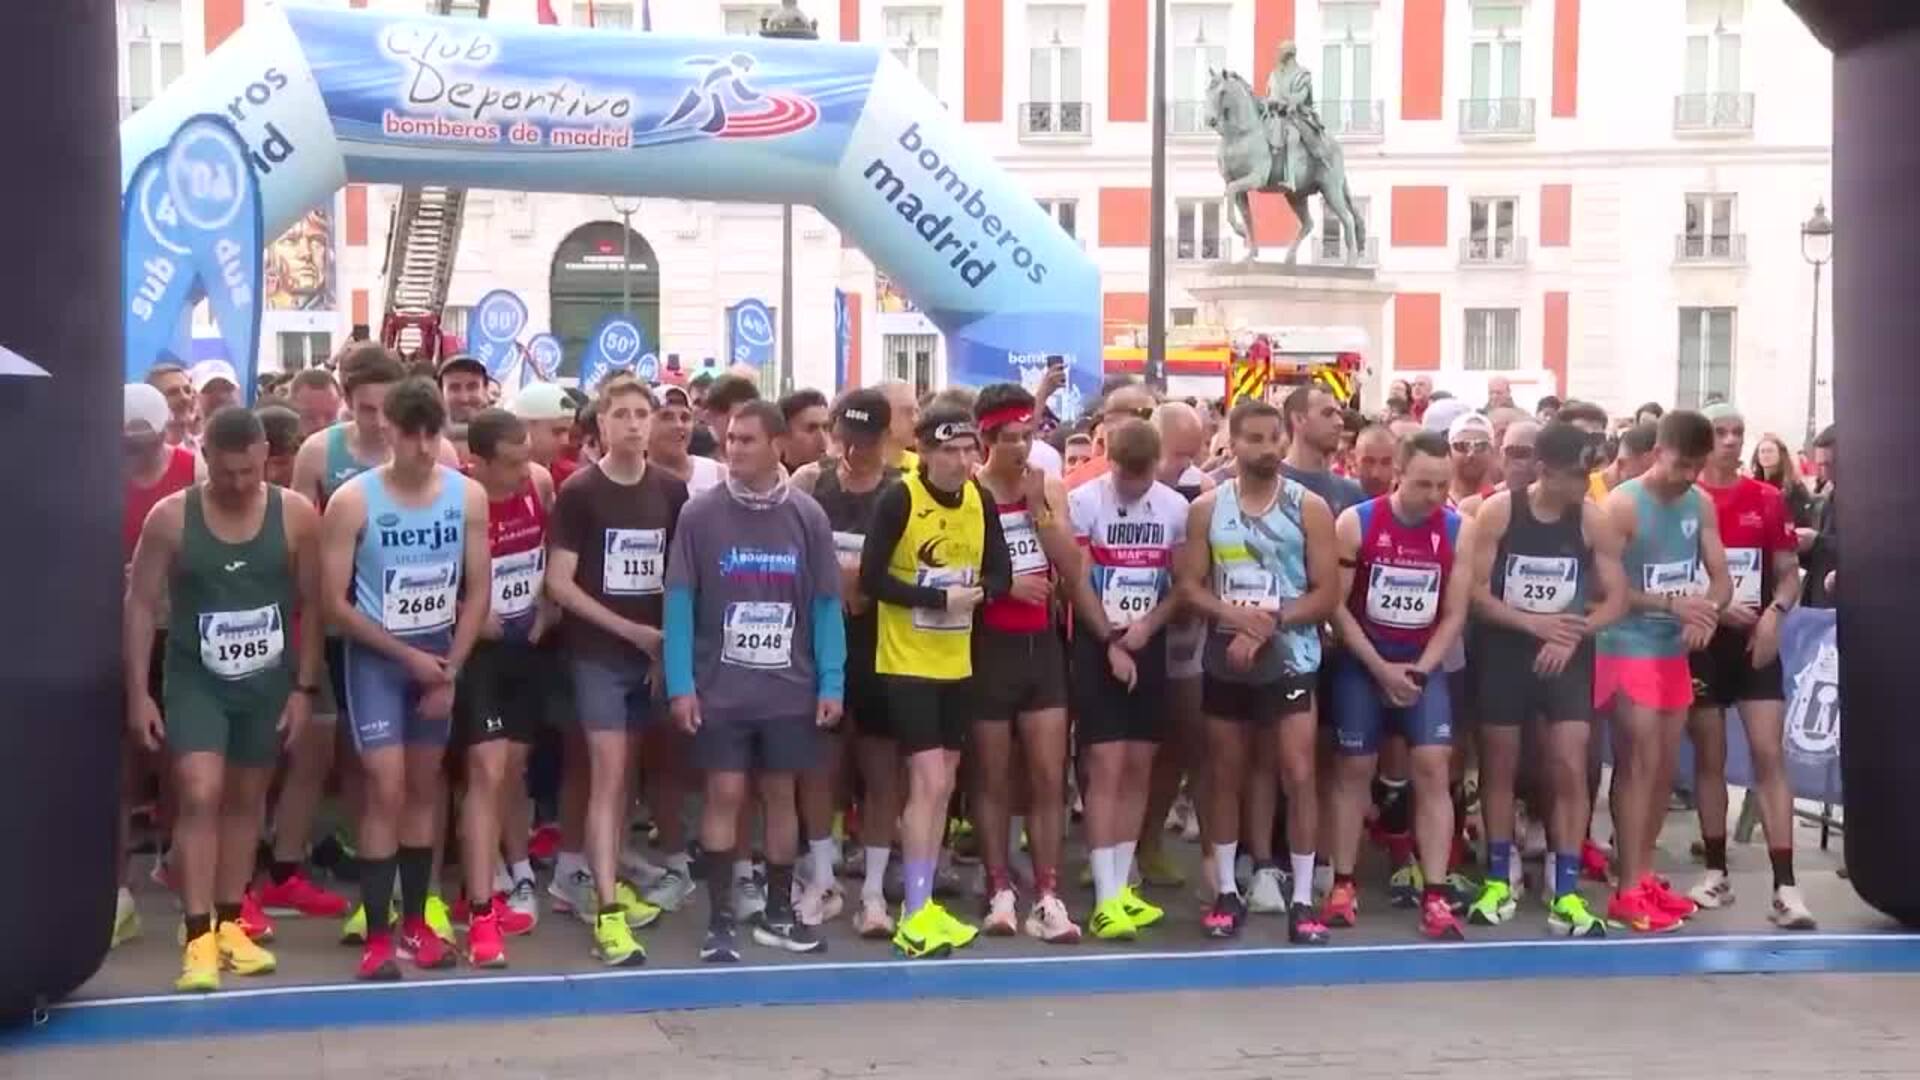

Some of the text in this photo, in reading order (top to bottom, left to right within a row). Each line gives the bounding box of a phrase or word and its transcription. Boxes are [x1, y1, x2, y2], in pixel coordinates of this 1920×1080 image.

[387, 29, 491, 61] Club
[408, 57, 631, 120] Deportivo
[386, 113, 630, 148] bomberos de madrid
[898, 121, 1048, 285] bomberos
[863, 158, 997, 289] madrid
[131, 256, 175, 321] sub
[606, 332, 636, 353] 50'
[381, 521, 458, 550] nerja
[623, 559, 655, 576] 1131
[502, 580, 531, 601] 681
[1523, 584, 1557, 601] 239
[398, 593, 446, 614] 2686
[1119, 596, 1151, 611] 609
[1381, 595, 1425, 612] 2436
[218, 639, 269, 661] 1985
[736, 633, 783, 649] 2048
